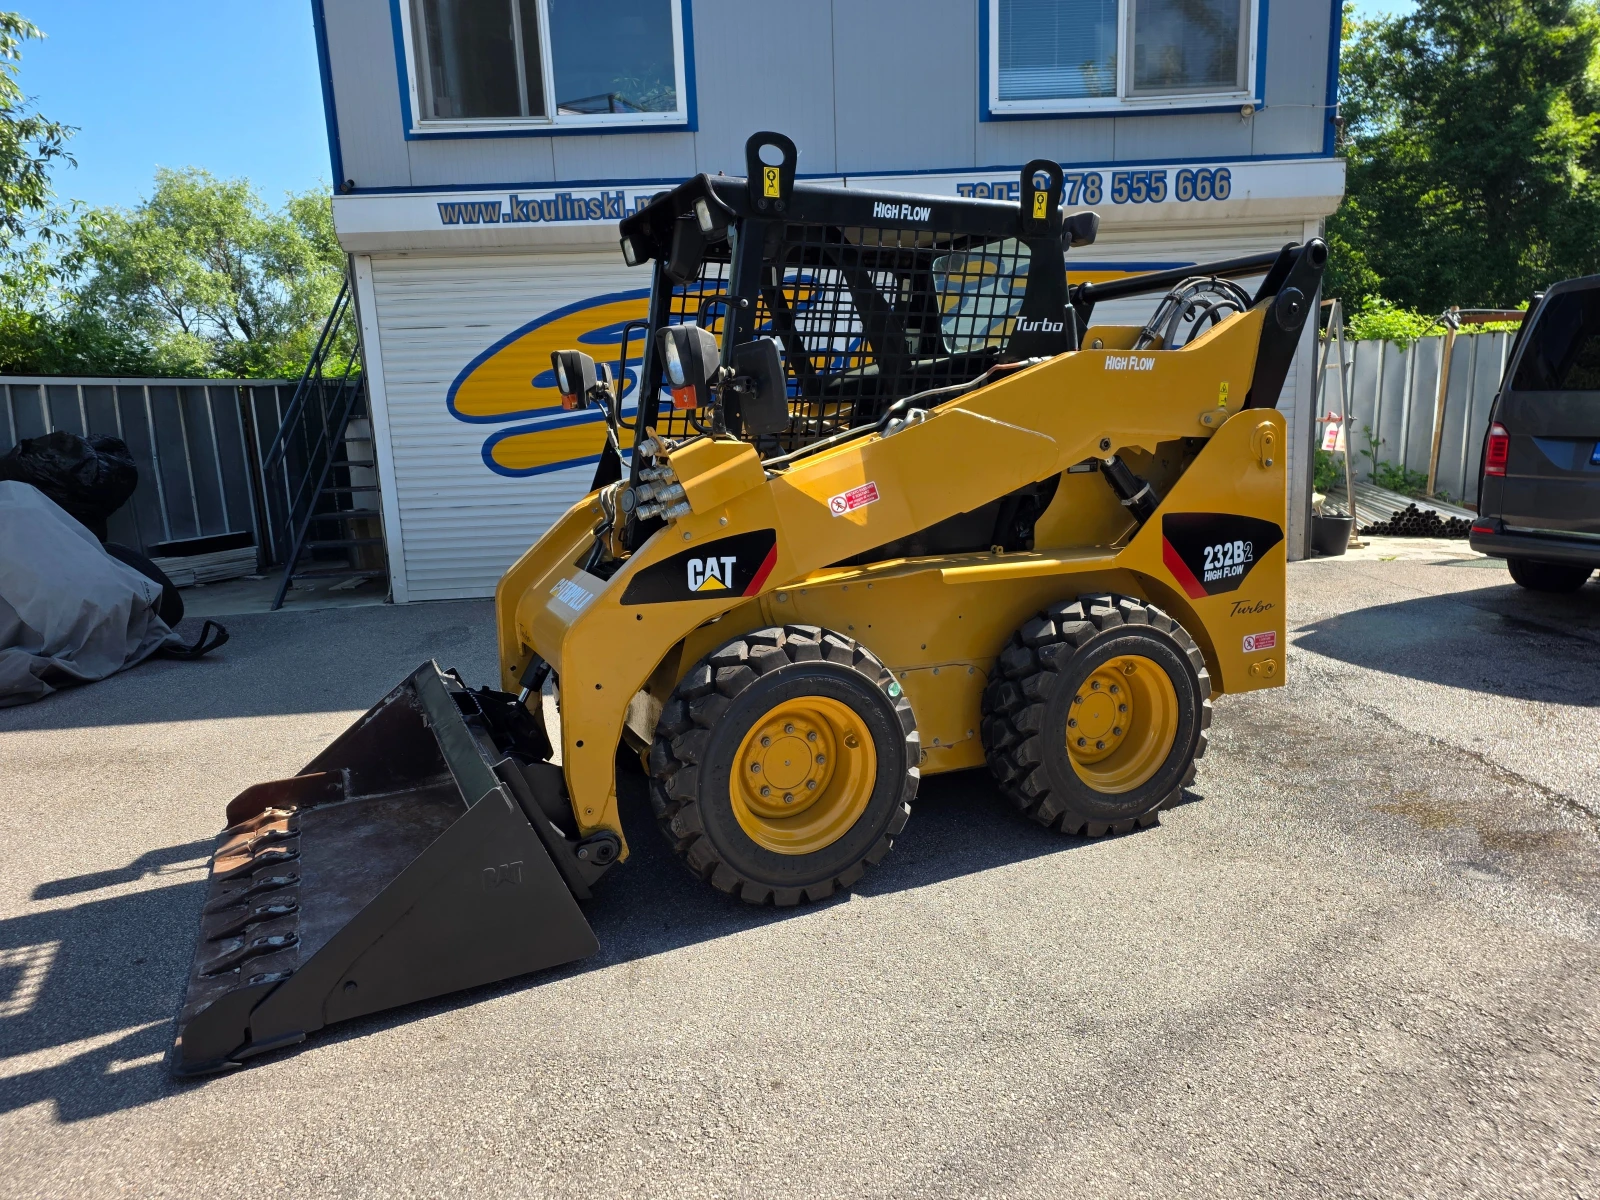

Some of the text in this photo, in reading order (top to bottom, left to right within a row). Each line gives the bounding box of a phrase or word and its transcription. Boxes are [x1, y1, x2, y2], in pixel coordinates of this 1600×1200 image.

[1031, 172, 1103, 205] 078
[1111, 170, 1168, 204] 555
[1176, 167, 1231, 202] 666
[873, 201, 931, 221] HIGH FLOW
[1015, 316, 1063, 332] Turbo
[1105, 355, 1155, 370] HIGH FLOW
[1203, 540, 1253, 570] 232B2
[687, 556, 737, 592] CAT
[1204, 564, 1244, 582] HIGH FLOW
[1230, 599, 1276, 618] Turbo
[482, 860, 524, 891] CAT
